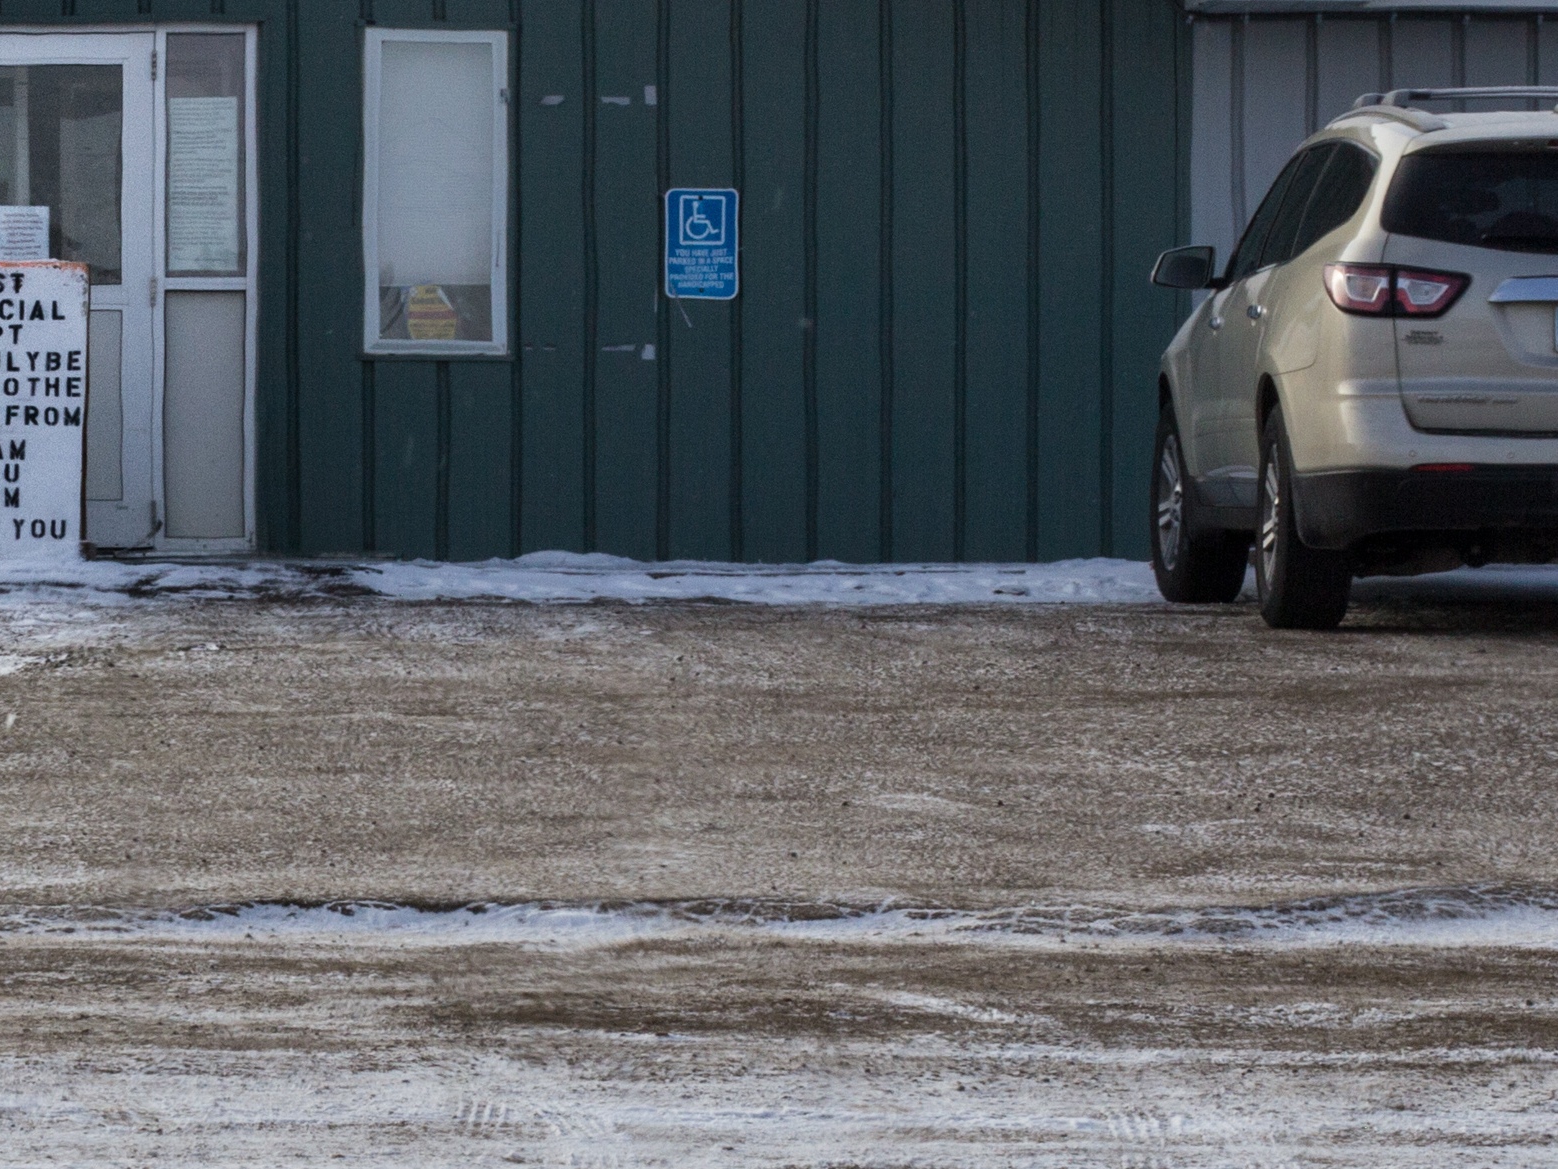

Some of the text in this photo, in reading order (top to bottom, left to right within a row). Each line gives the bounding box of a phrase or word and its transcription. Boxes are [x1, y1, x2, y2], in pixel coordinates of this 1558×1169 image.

[44, 350, 82, 372] BE
[27, 377, 82, 398] THE
[5, 404, 82, 427] FROM
[12, 518, 68, 540] YOU
